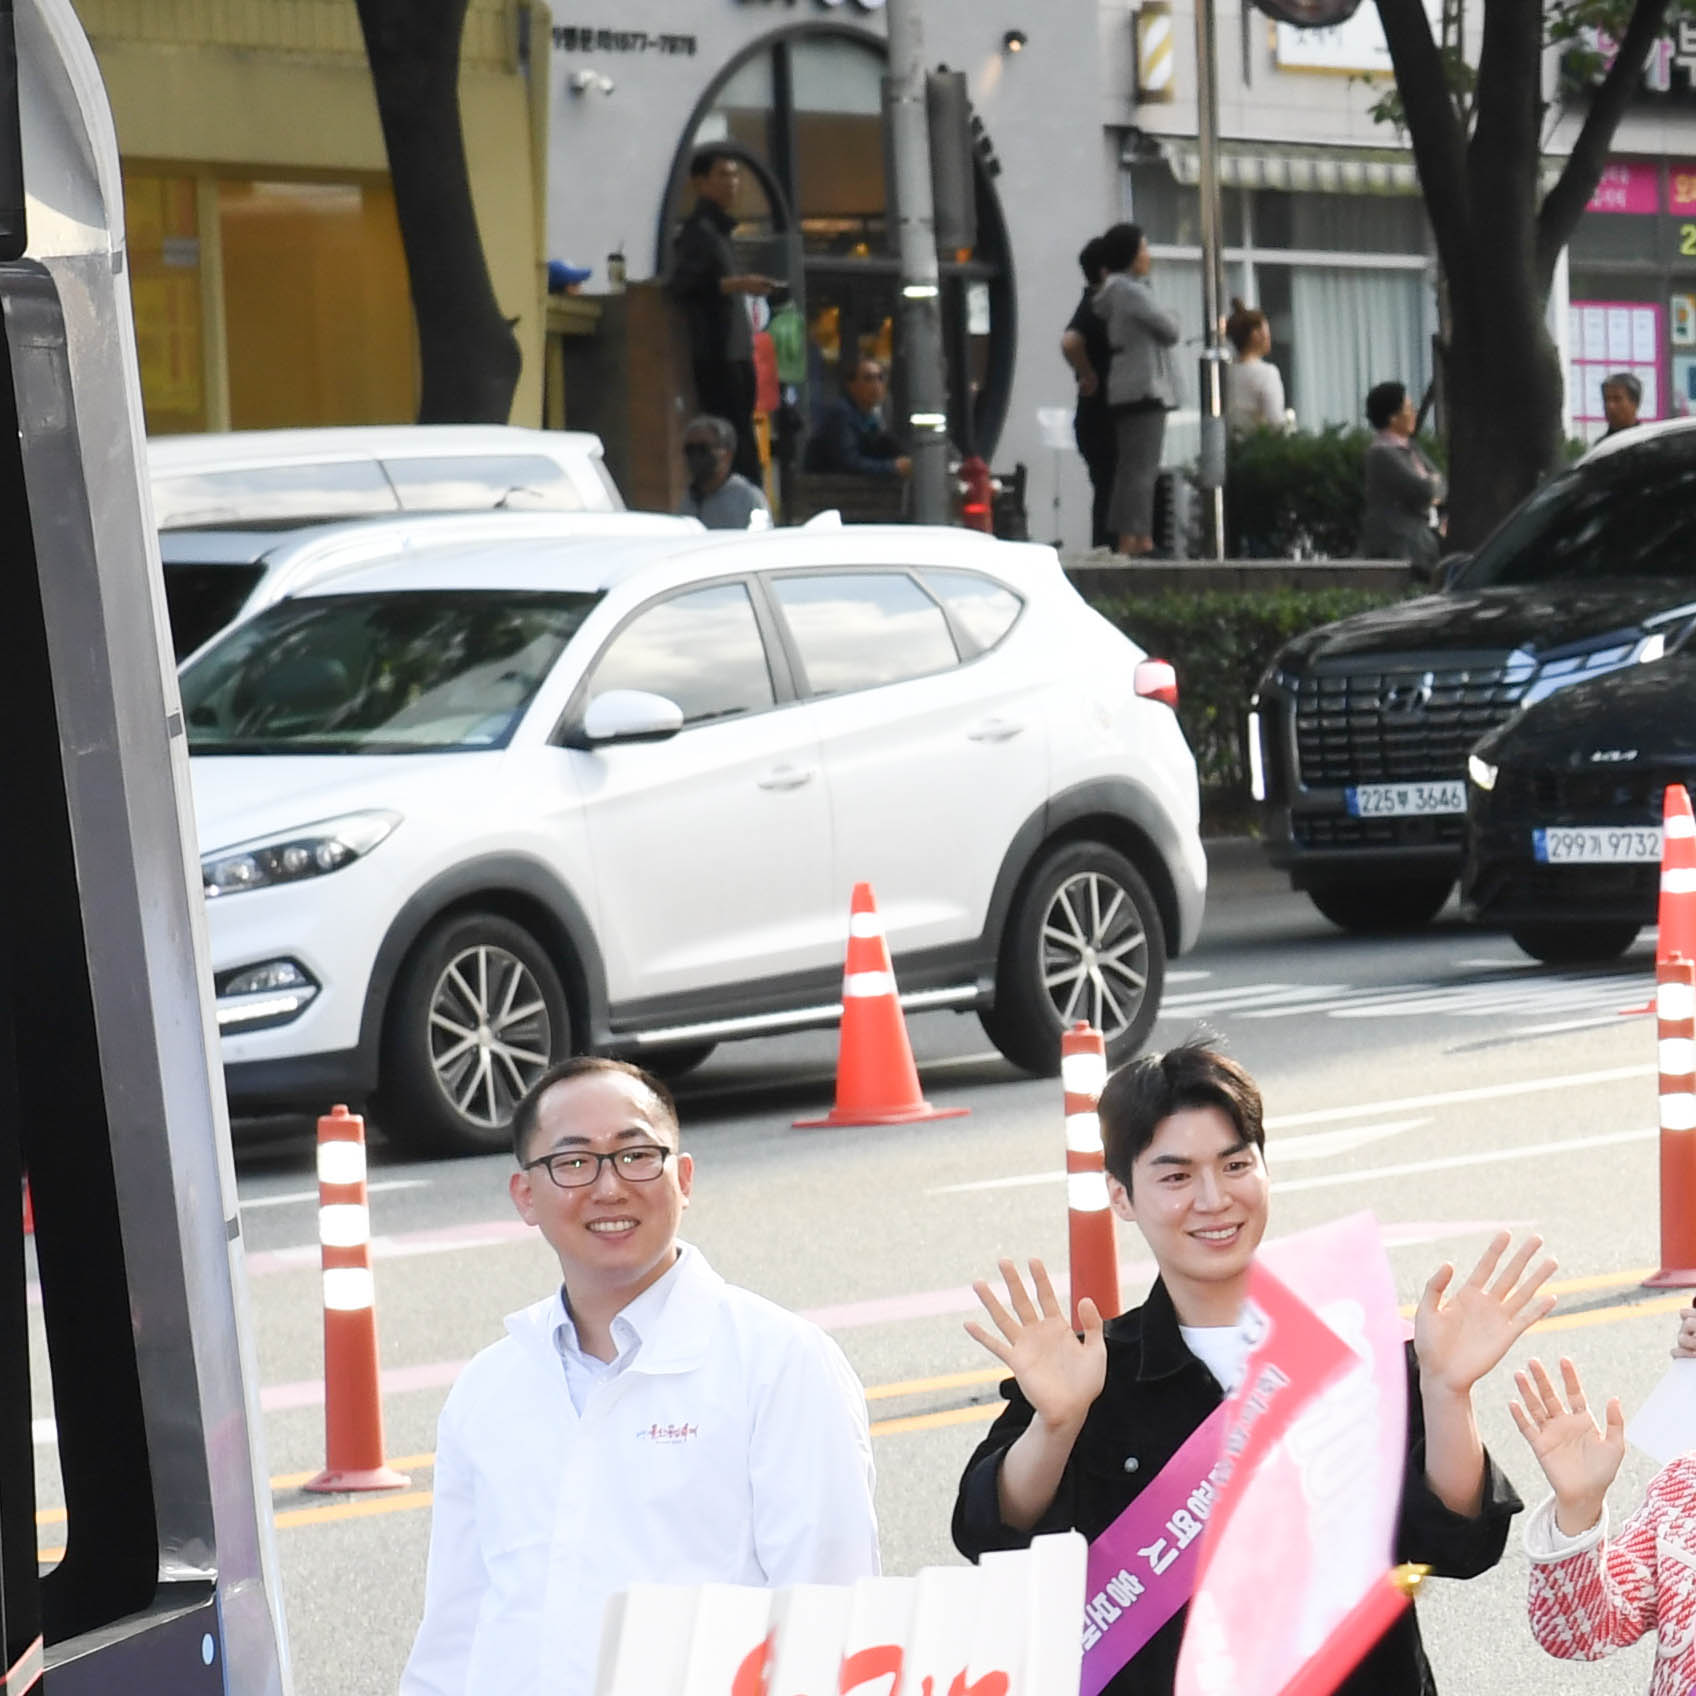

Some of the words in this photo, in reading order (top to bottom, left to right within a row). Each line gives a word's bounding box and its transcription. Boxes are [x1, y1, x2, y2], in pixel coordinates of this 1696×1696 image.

[1415, 787, 1462, 810] 3646
[1608, 830, 1660, 858] 9732
[1080, 1567, 1146, 1652] 홍보대
